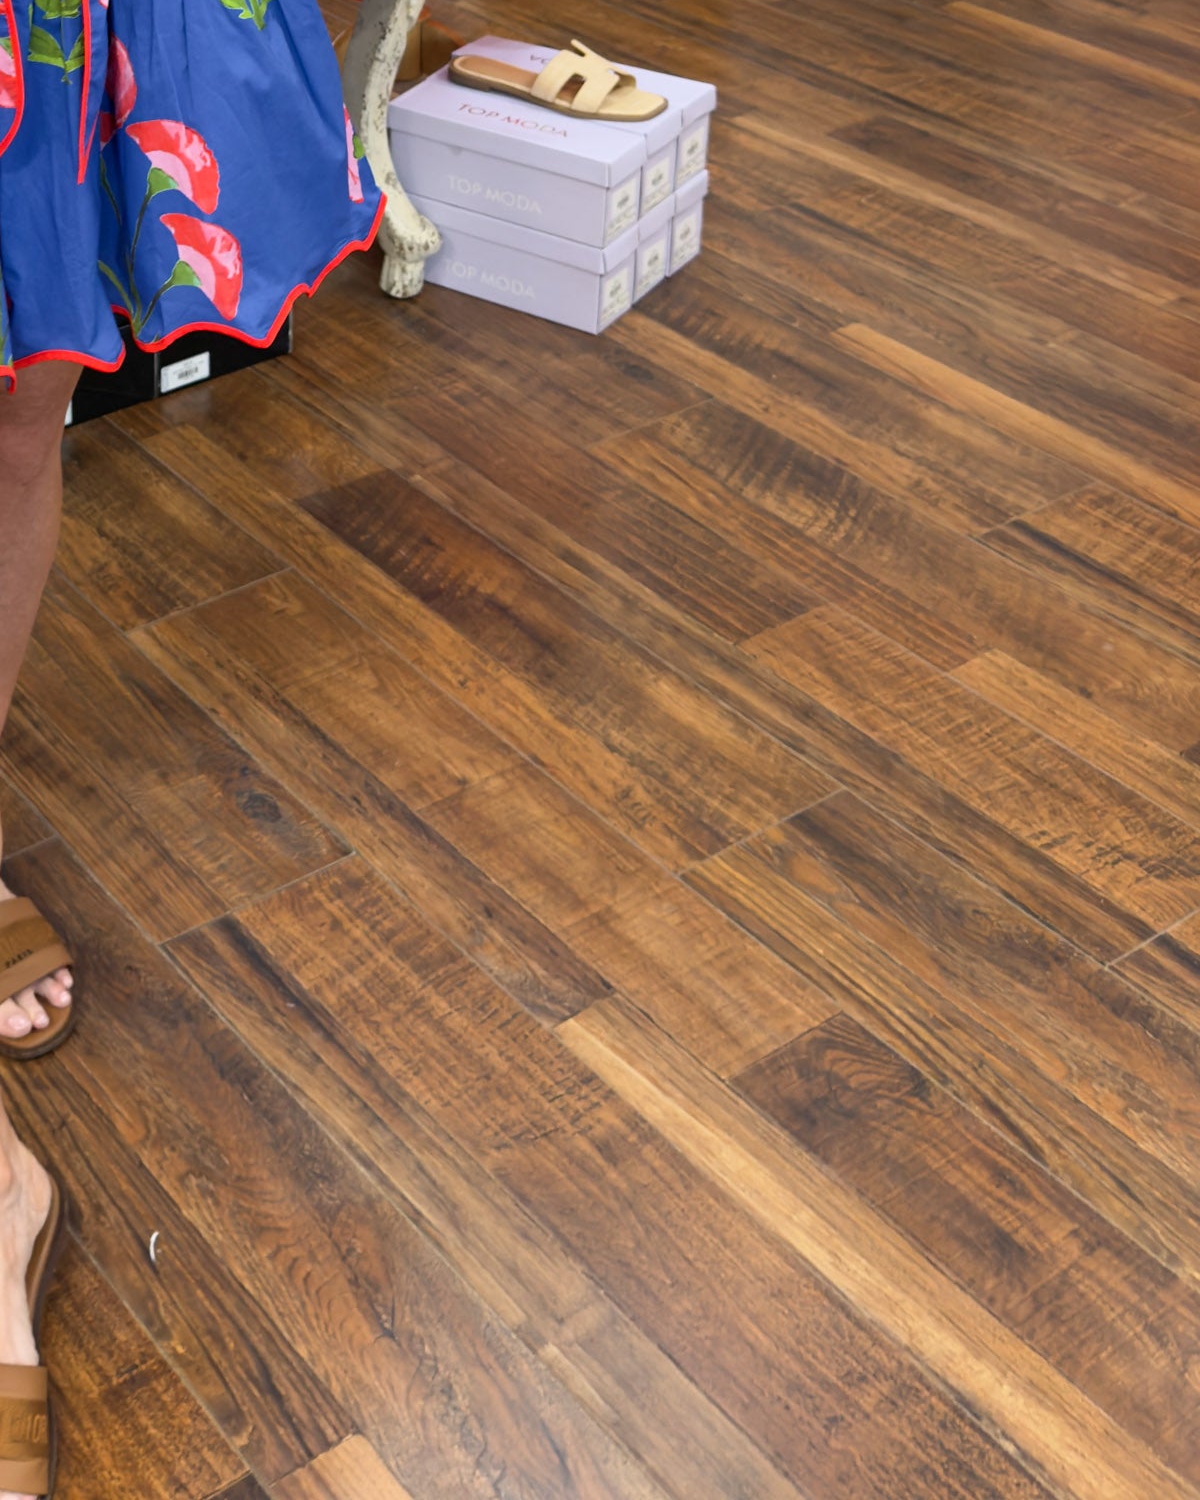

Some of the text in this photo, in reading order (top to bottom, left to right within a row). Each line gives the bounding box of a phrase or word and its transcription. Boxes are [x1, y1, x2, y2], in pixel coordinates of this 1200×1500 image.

[459, 104, 567, 137] TOP MODA
[448, 175, 541, 214] TOP MODA
[445, 260, 535, 298] TOP MODA
